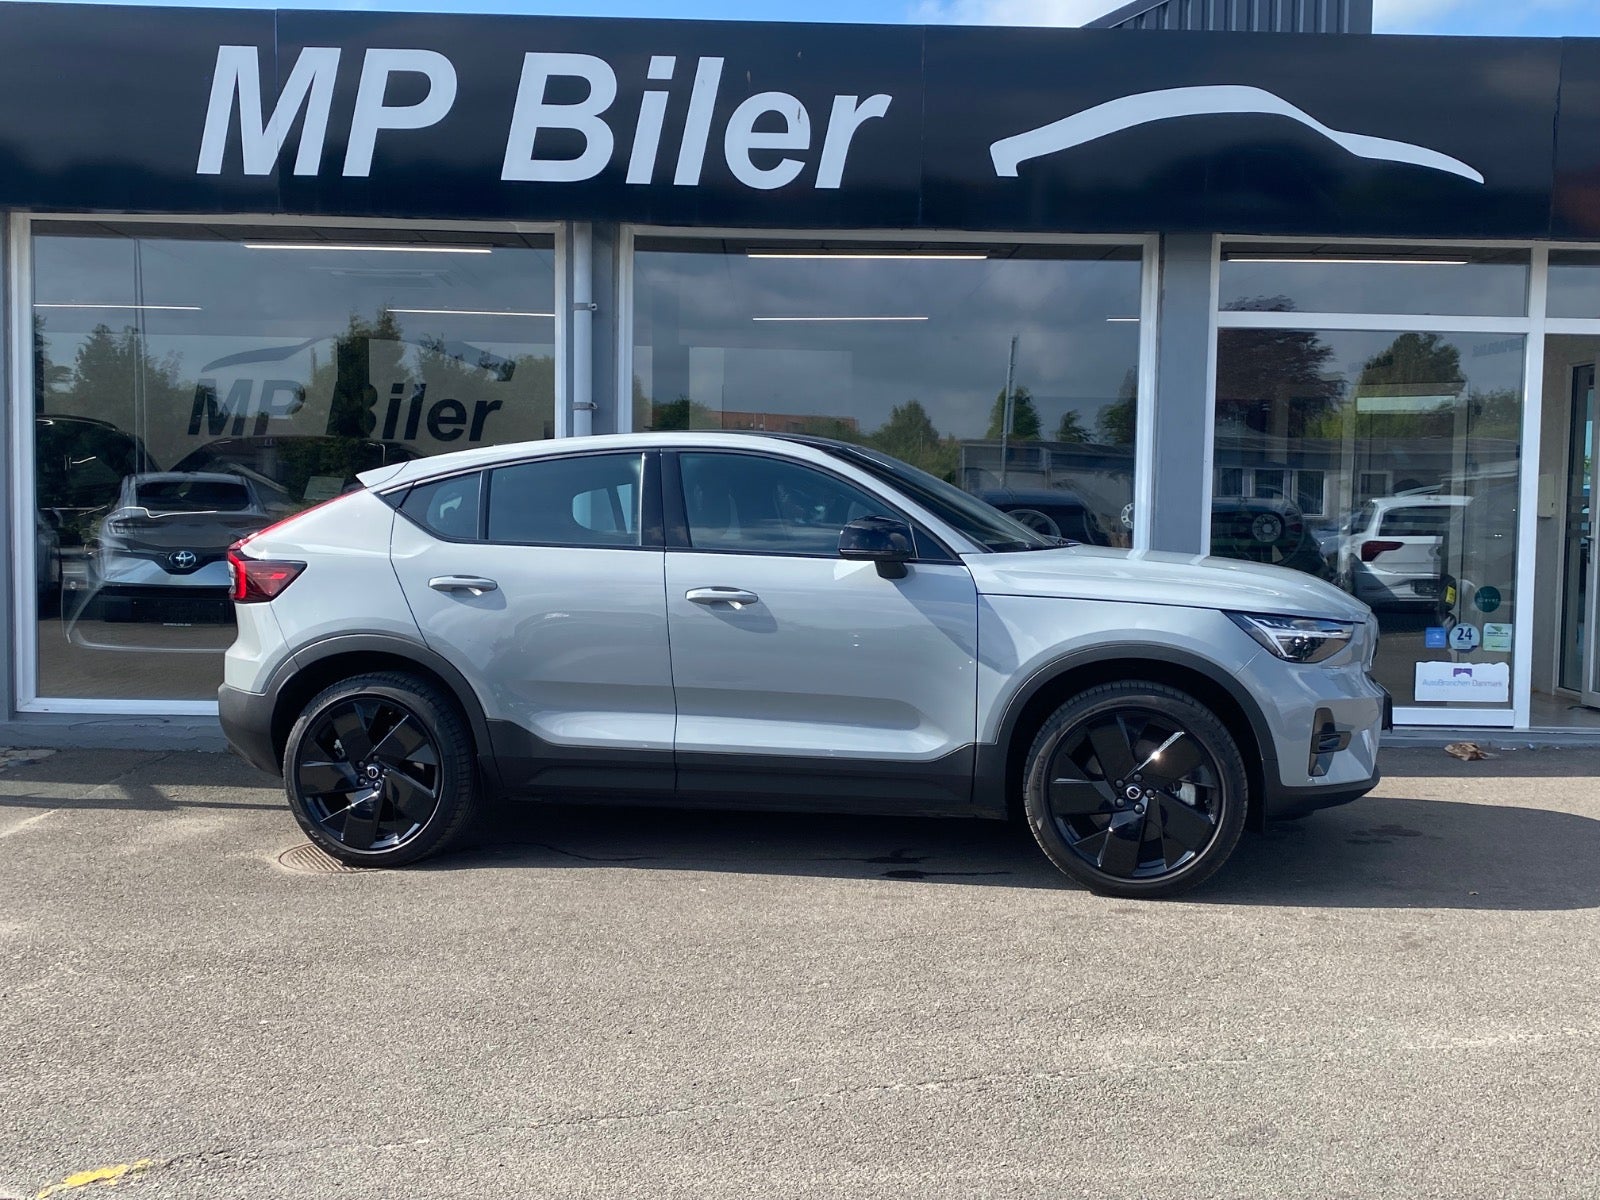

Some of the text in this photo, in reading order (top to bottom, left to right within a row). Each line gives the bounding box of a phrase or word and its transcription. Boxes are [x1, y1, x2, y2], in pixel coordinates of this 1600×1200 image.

[196, 45, 893, 191] MP Biler
[188, 378, 503, 442] MP Biler
[1456, 627, 1473, 640] 24
